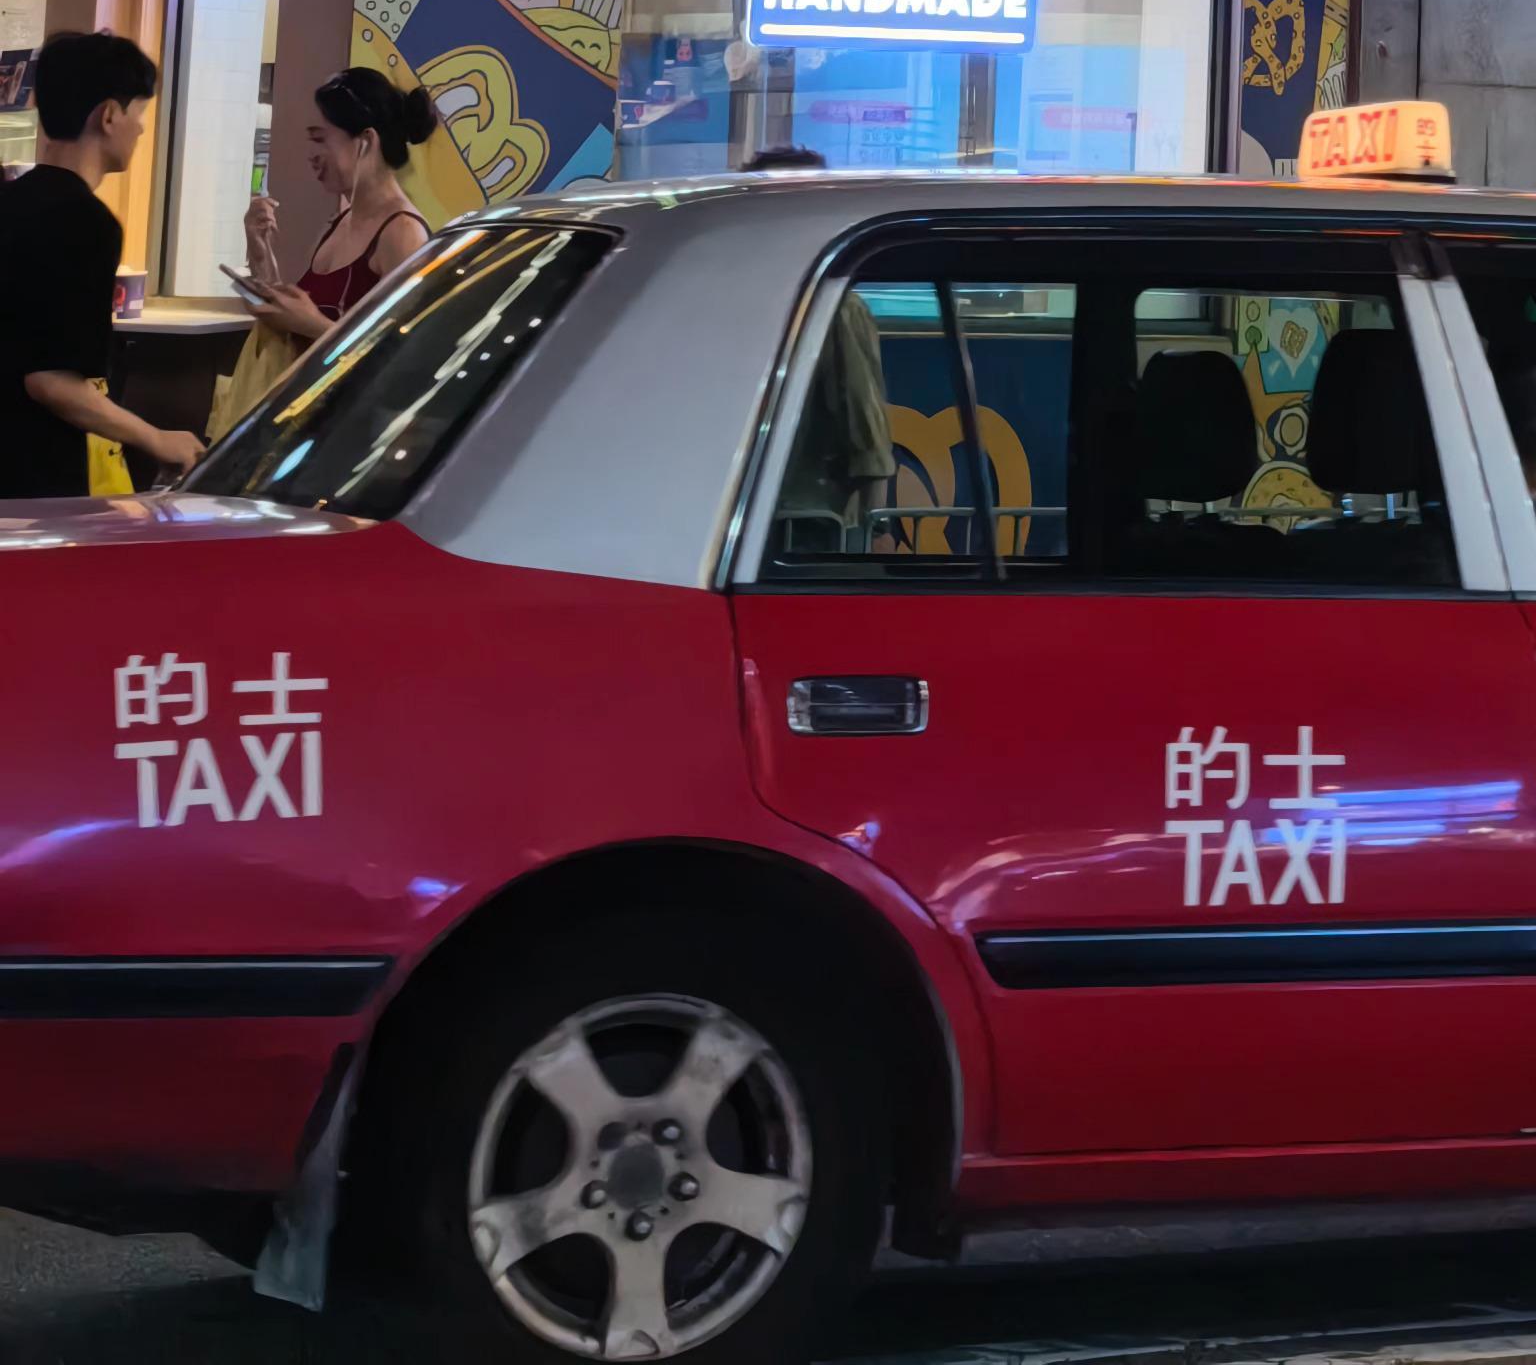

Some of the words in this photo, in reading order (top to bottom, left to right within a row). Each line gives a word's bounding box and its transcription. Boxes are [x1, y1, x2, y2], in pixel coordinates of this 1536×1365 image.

[1309, 108, 1398, 168] TAXI
[113, 652, 329, 728] 的士
[113, 731, 323, 828] TAXI
[1165, 726, 1346, 809] 的士
[1165, 818, 1348, 906] TAXI
